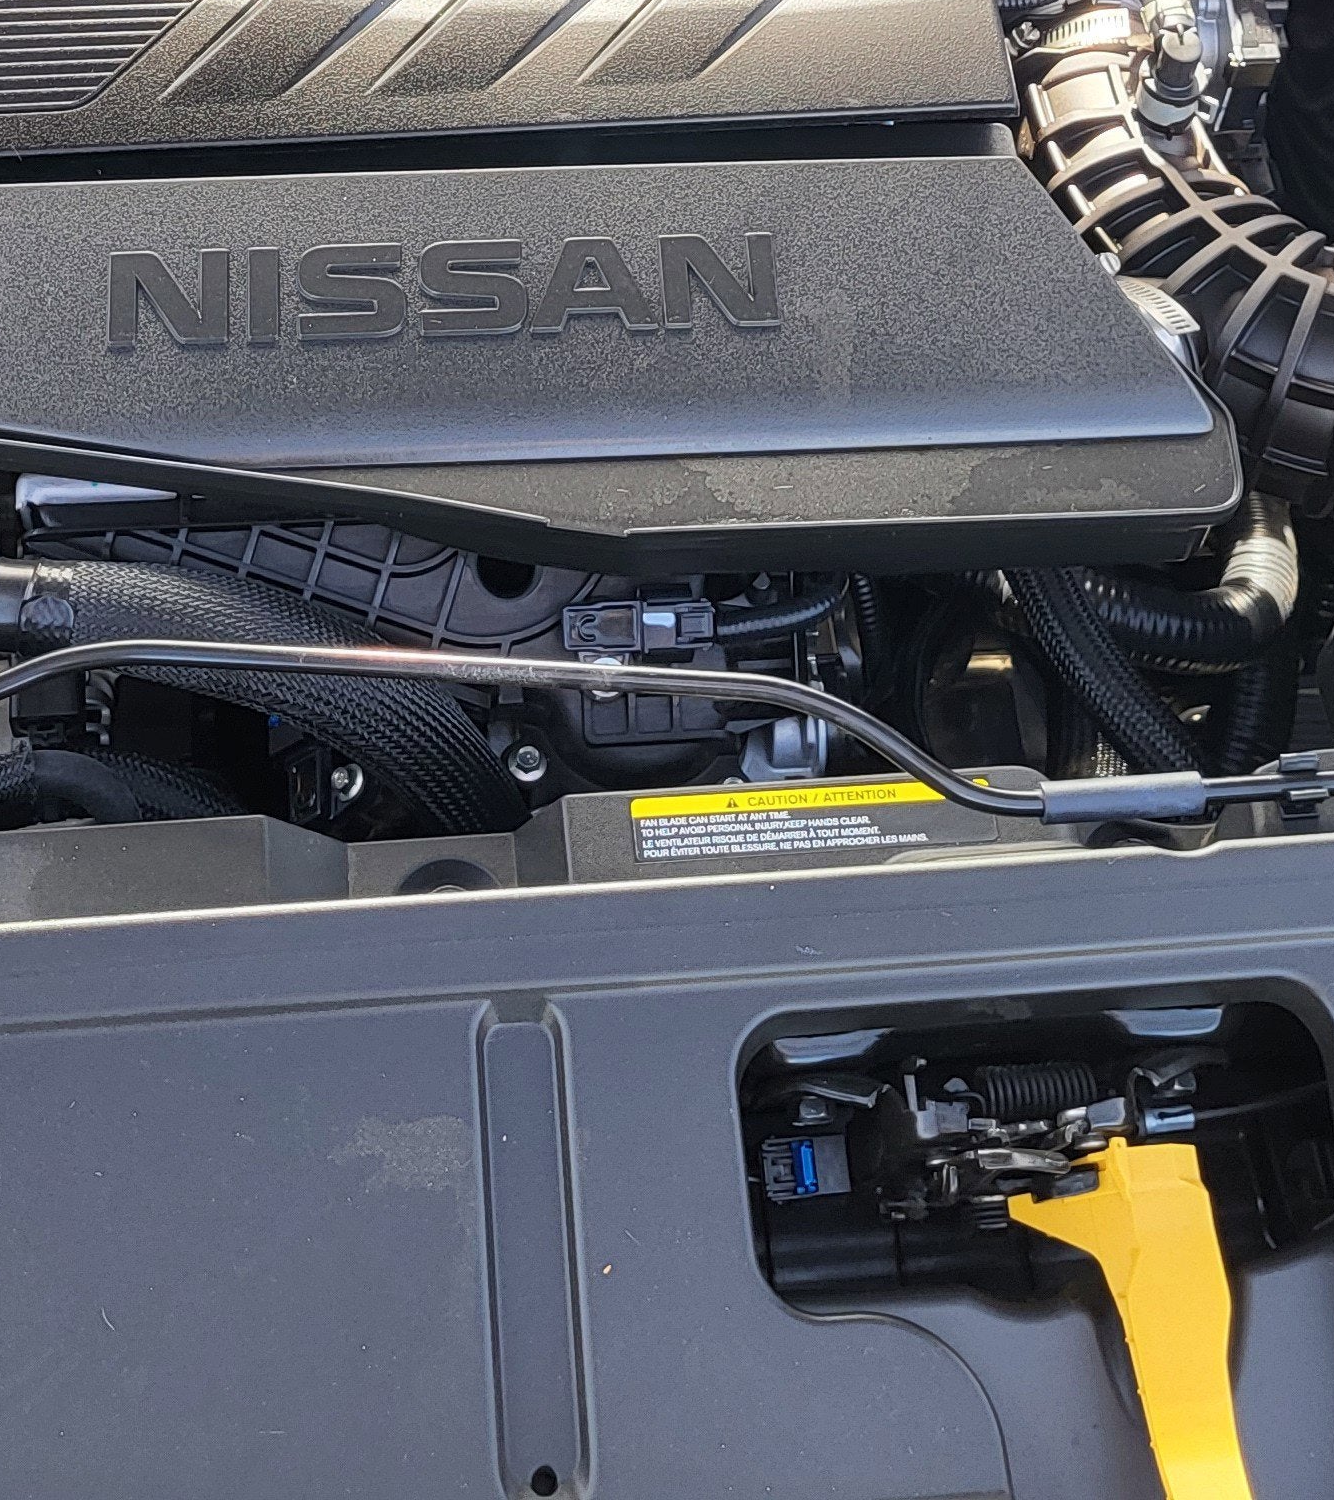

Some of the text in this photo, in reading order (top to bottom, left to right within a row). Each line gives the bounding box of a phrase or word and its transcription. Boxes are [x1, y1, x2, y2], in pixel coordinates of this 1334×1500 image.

[107, 231, 784, 347] NISSAN
[748, 794, 808, 807] CAUTION
[823, 788, 897, 802] ATTENTION
[640, 810, 791, 828] FAN BLADE CAN START AT ANY TIME.
[641, 829, 654, 837] TO
[655, 827, 678, 837] HELP
[679, 825, 706, 835] AVOID
[707, 823, 754, 833] PERSONAL
[808, 817, 839, 827] HANDS
[840, 815, 871, 825] CLEAR.
[642, 826, 881, 848] LE VENTILATEUR RISQUE DE DÉMARRER À TOUT MOMENT.
[644, 848, 670, 858] POUR
[671, 847, 701, 857] ÉVITER
[702, 845, 730, 855] TOUTE
[780, 841, 792, 850] NE
[793, 840, 812, 849] PAS
[812, 839, 825, 848] EN
[826, 836, 881, 847] APPROCHER
[881, 835, 898, 844] LES
[899, 833, 929, 843] MAINS.
